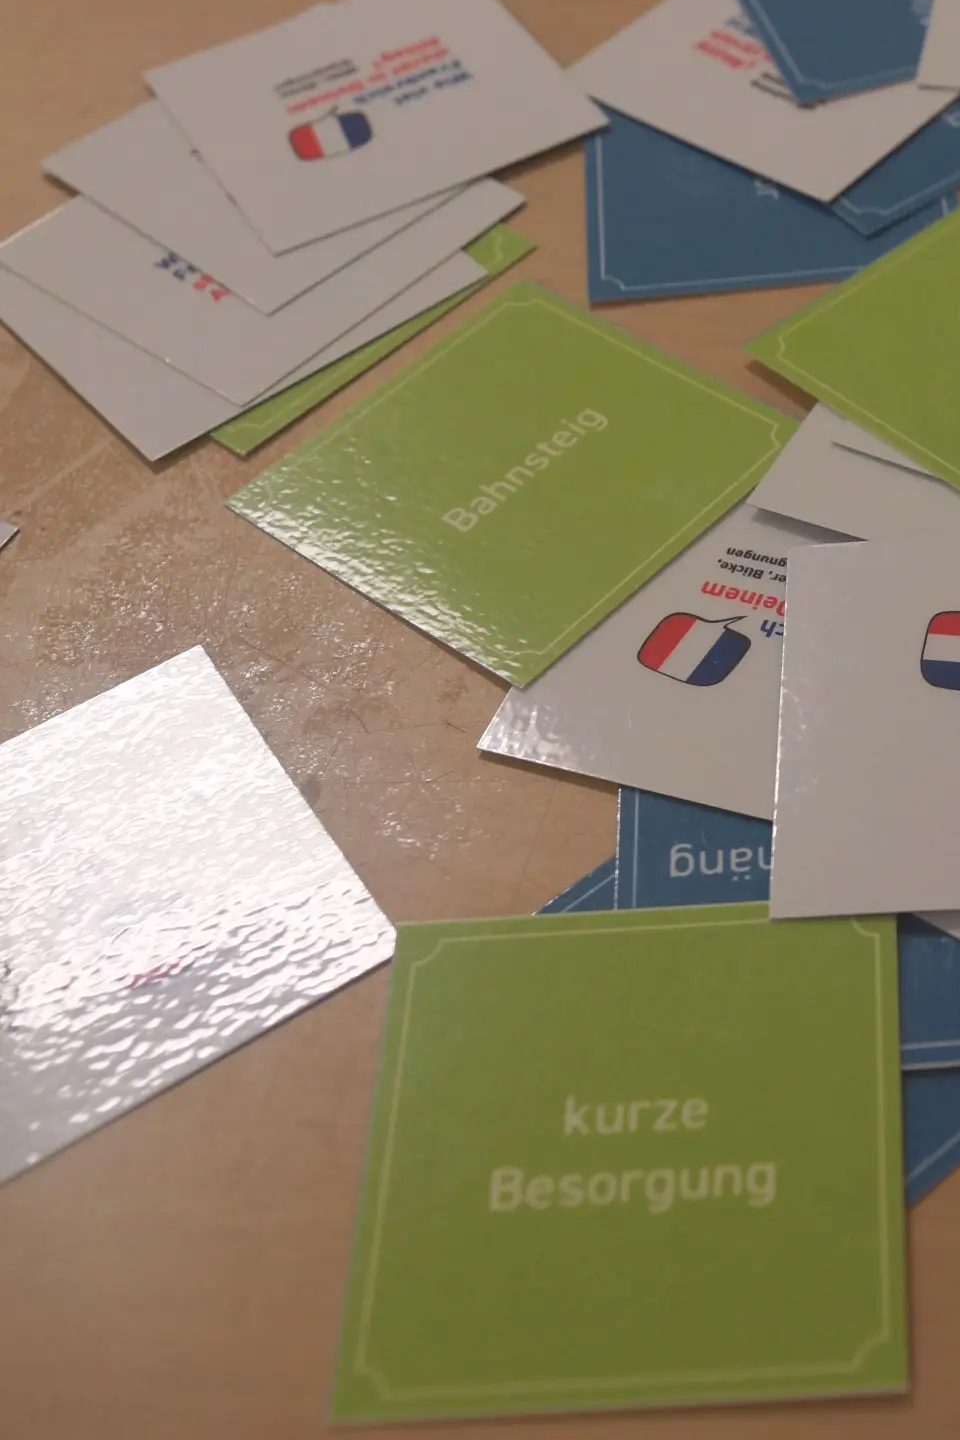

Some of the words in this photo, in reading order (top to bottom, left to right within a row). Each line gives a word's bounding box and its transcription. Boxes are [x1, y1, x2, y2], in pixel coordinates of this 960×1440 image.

[441, 408, 609, 533] Bahnsteig
[717, 558, 765, 580] Blicke,
[563, 1093, 710, 1138] kurze
[489, 1160, 778, 1214] Besorgung
